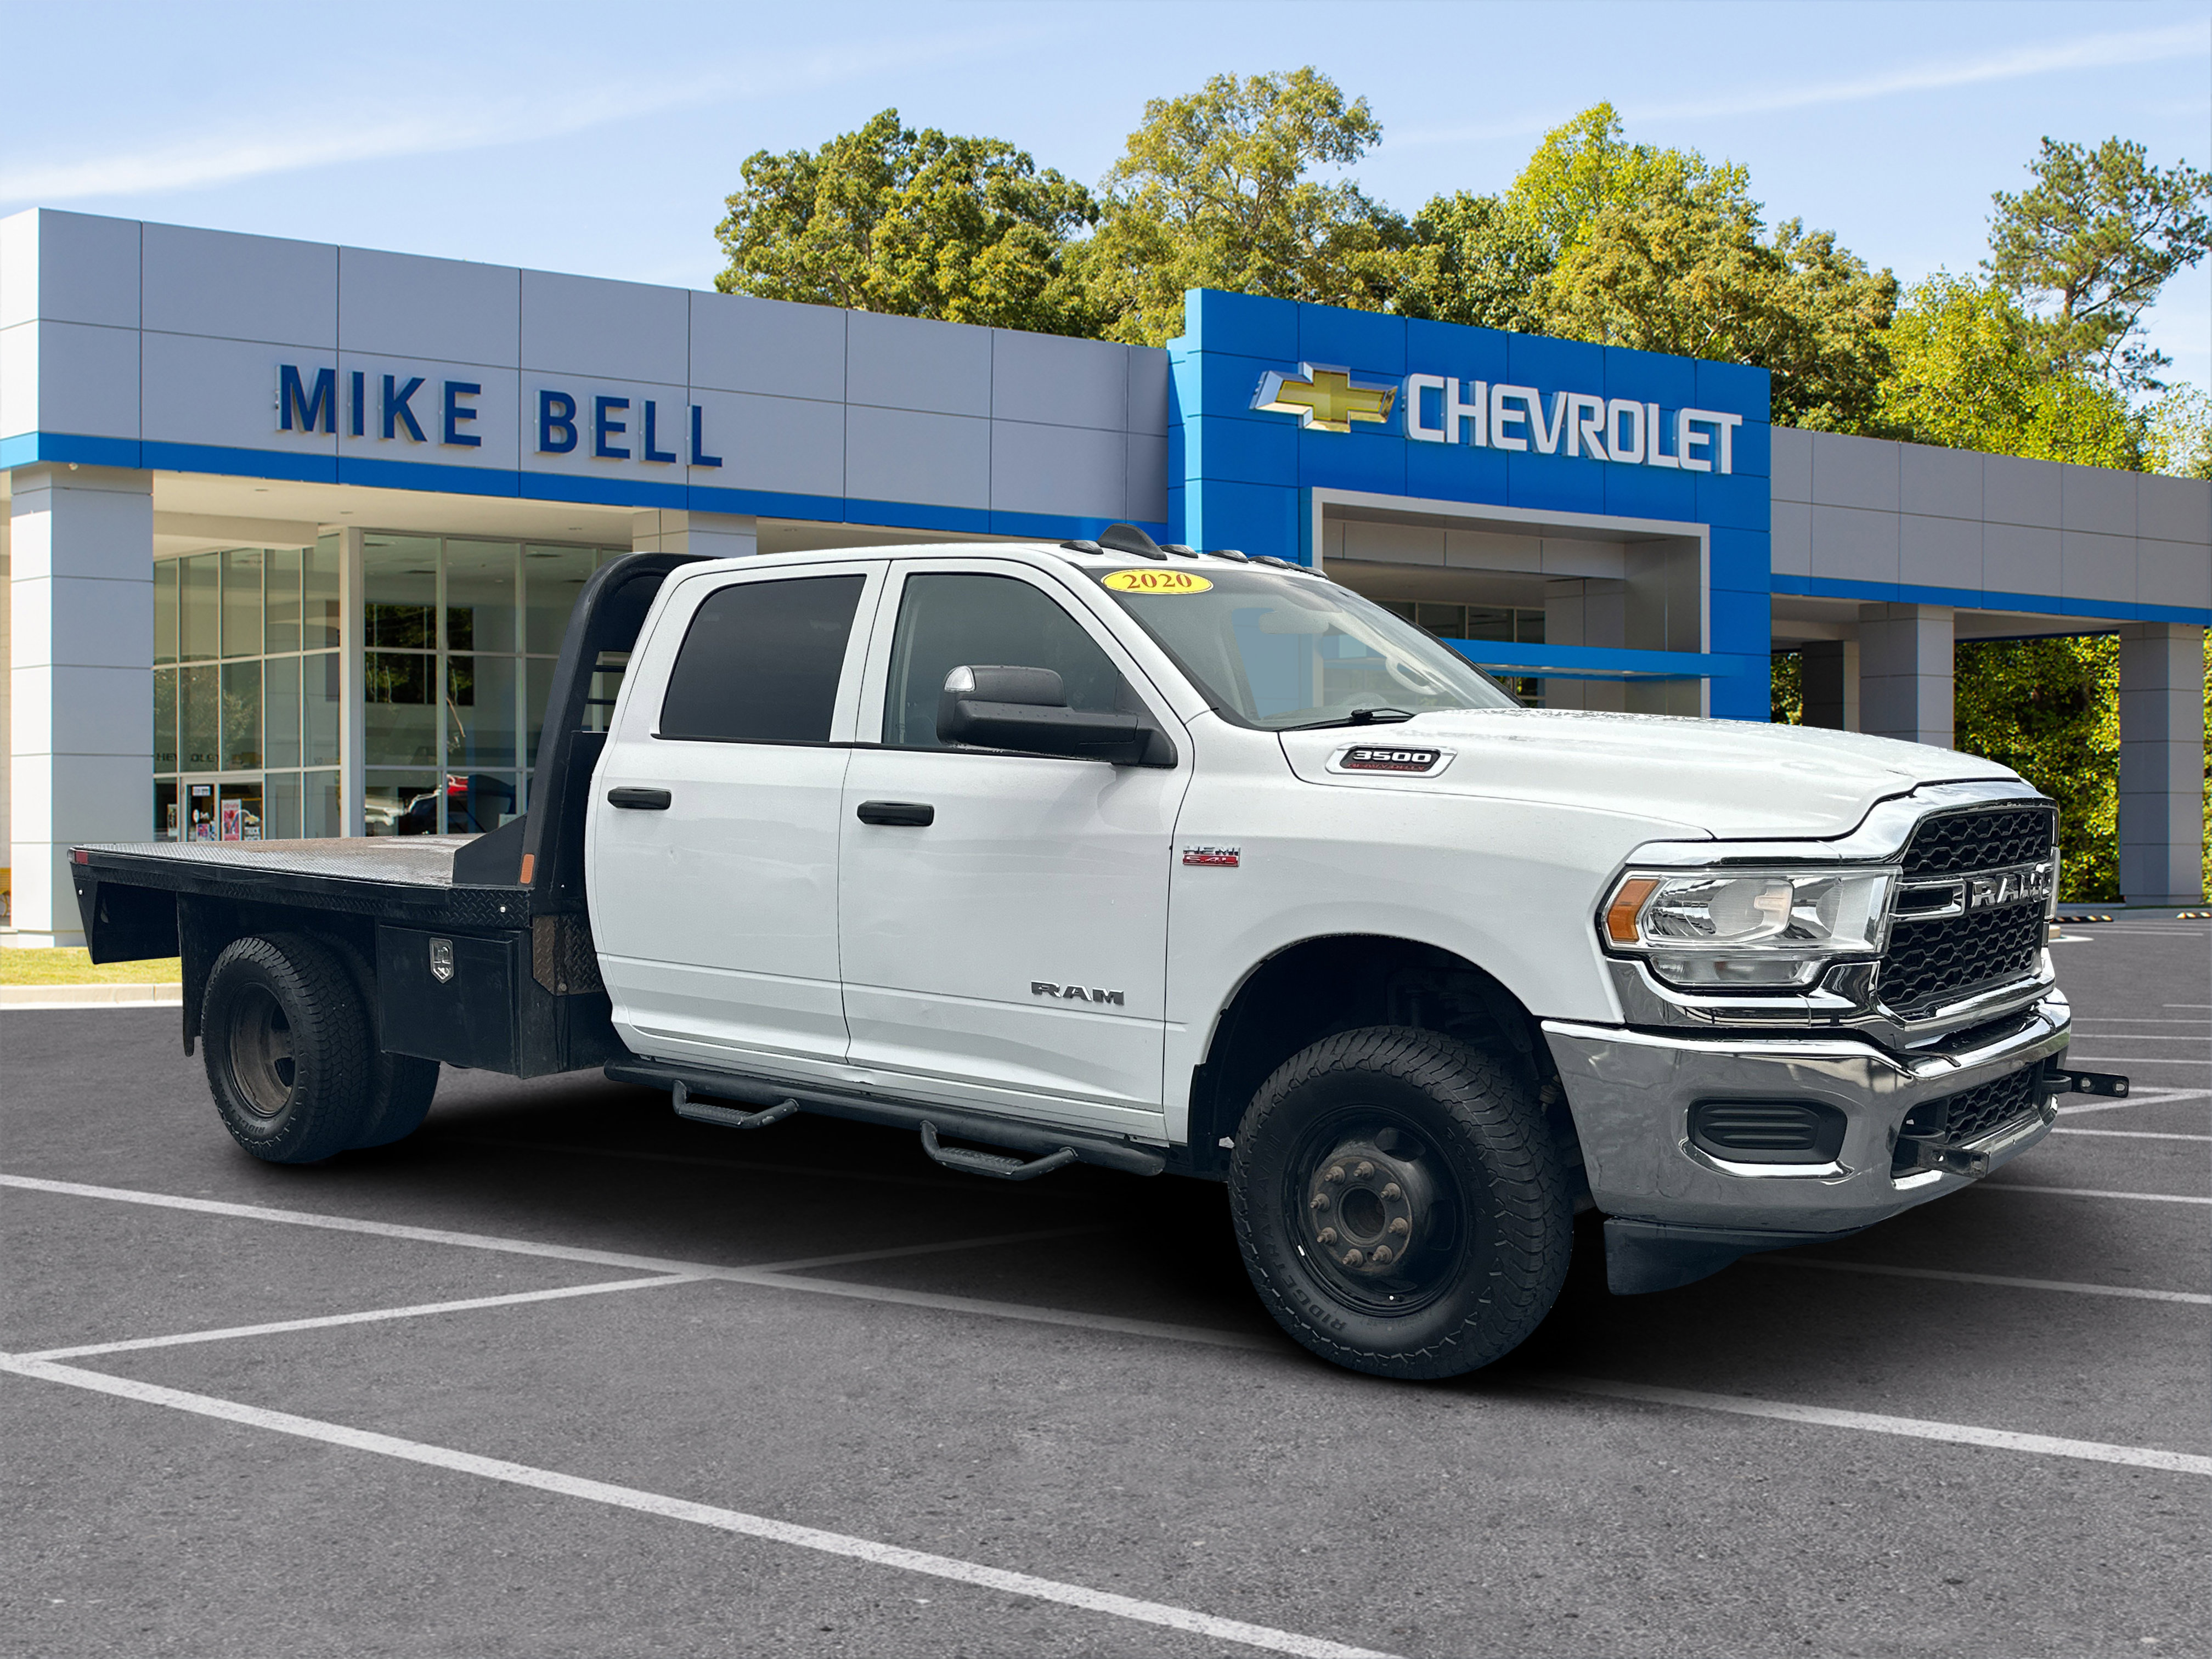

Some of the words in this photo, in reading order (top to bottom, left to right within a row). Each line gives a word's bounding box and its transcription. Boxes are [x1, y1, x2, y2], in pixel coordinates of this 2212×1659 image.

[276, 364, 481, 447] MIKE
[535, 390, 723, 467] BELL
[1404, 373, 1742, 475] CHEVROLET
[1122, 574, 1192, 589] 2020
[1353, 750, 1431, 763] 3500
[1183, 845, 1241, 856] HEMI
[1031, 980, 1125, 1006] RAM
[1256, 1200, 1347, 1331] RIDGETRAK
